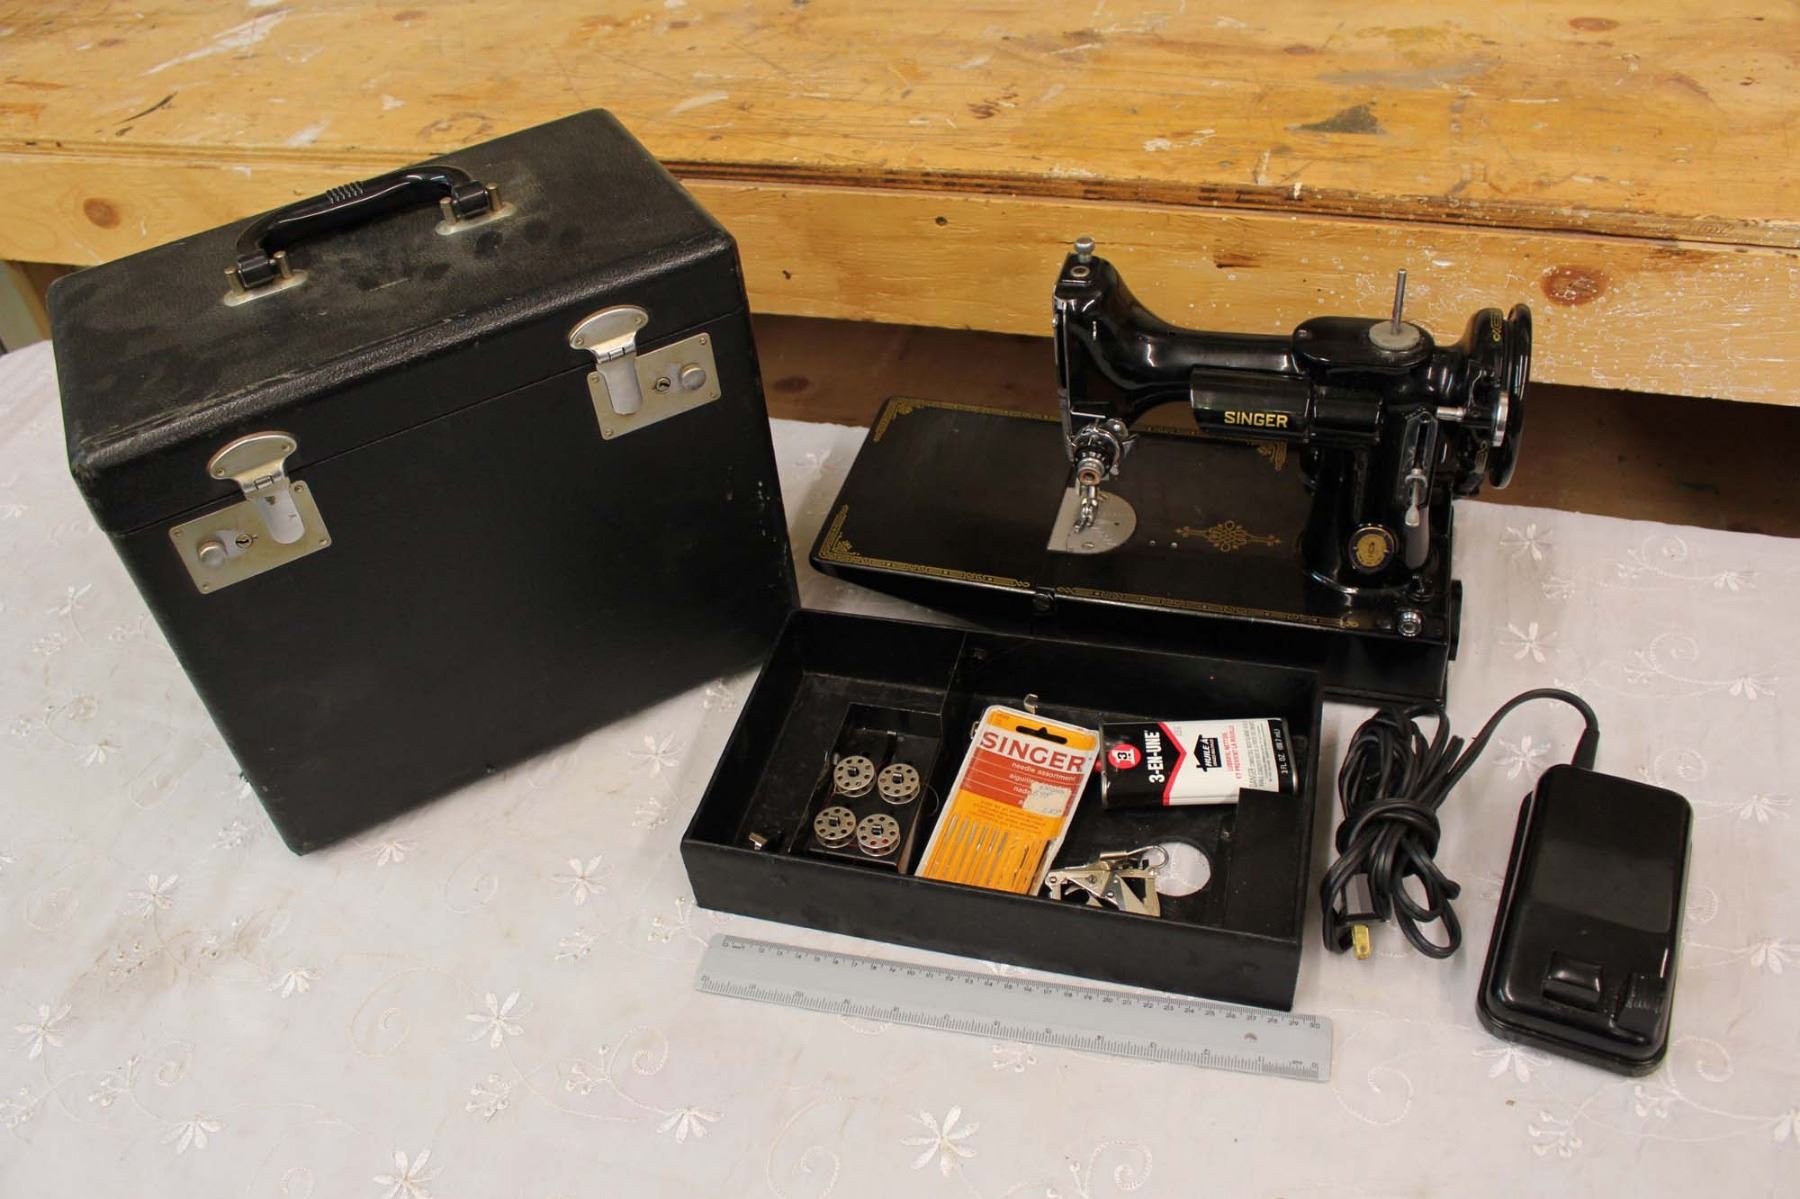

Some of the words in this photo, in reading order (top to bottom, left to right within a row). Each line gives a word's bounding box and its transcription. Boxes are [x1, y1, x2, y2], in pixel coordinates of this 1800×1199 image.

[1224, 411, 1289, 428] SINGER
[980, 731, 1086, 772] SINGER
[1144, 731, 1166, 783] 3-EN-UNE
[1202, 744, 1213, 767] HUILE
[1011, 762, 1036, 774] needle
[1037, 769, 1077, 782] assortment
